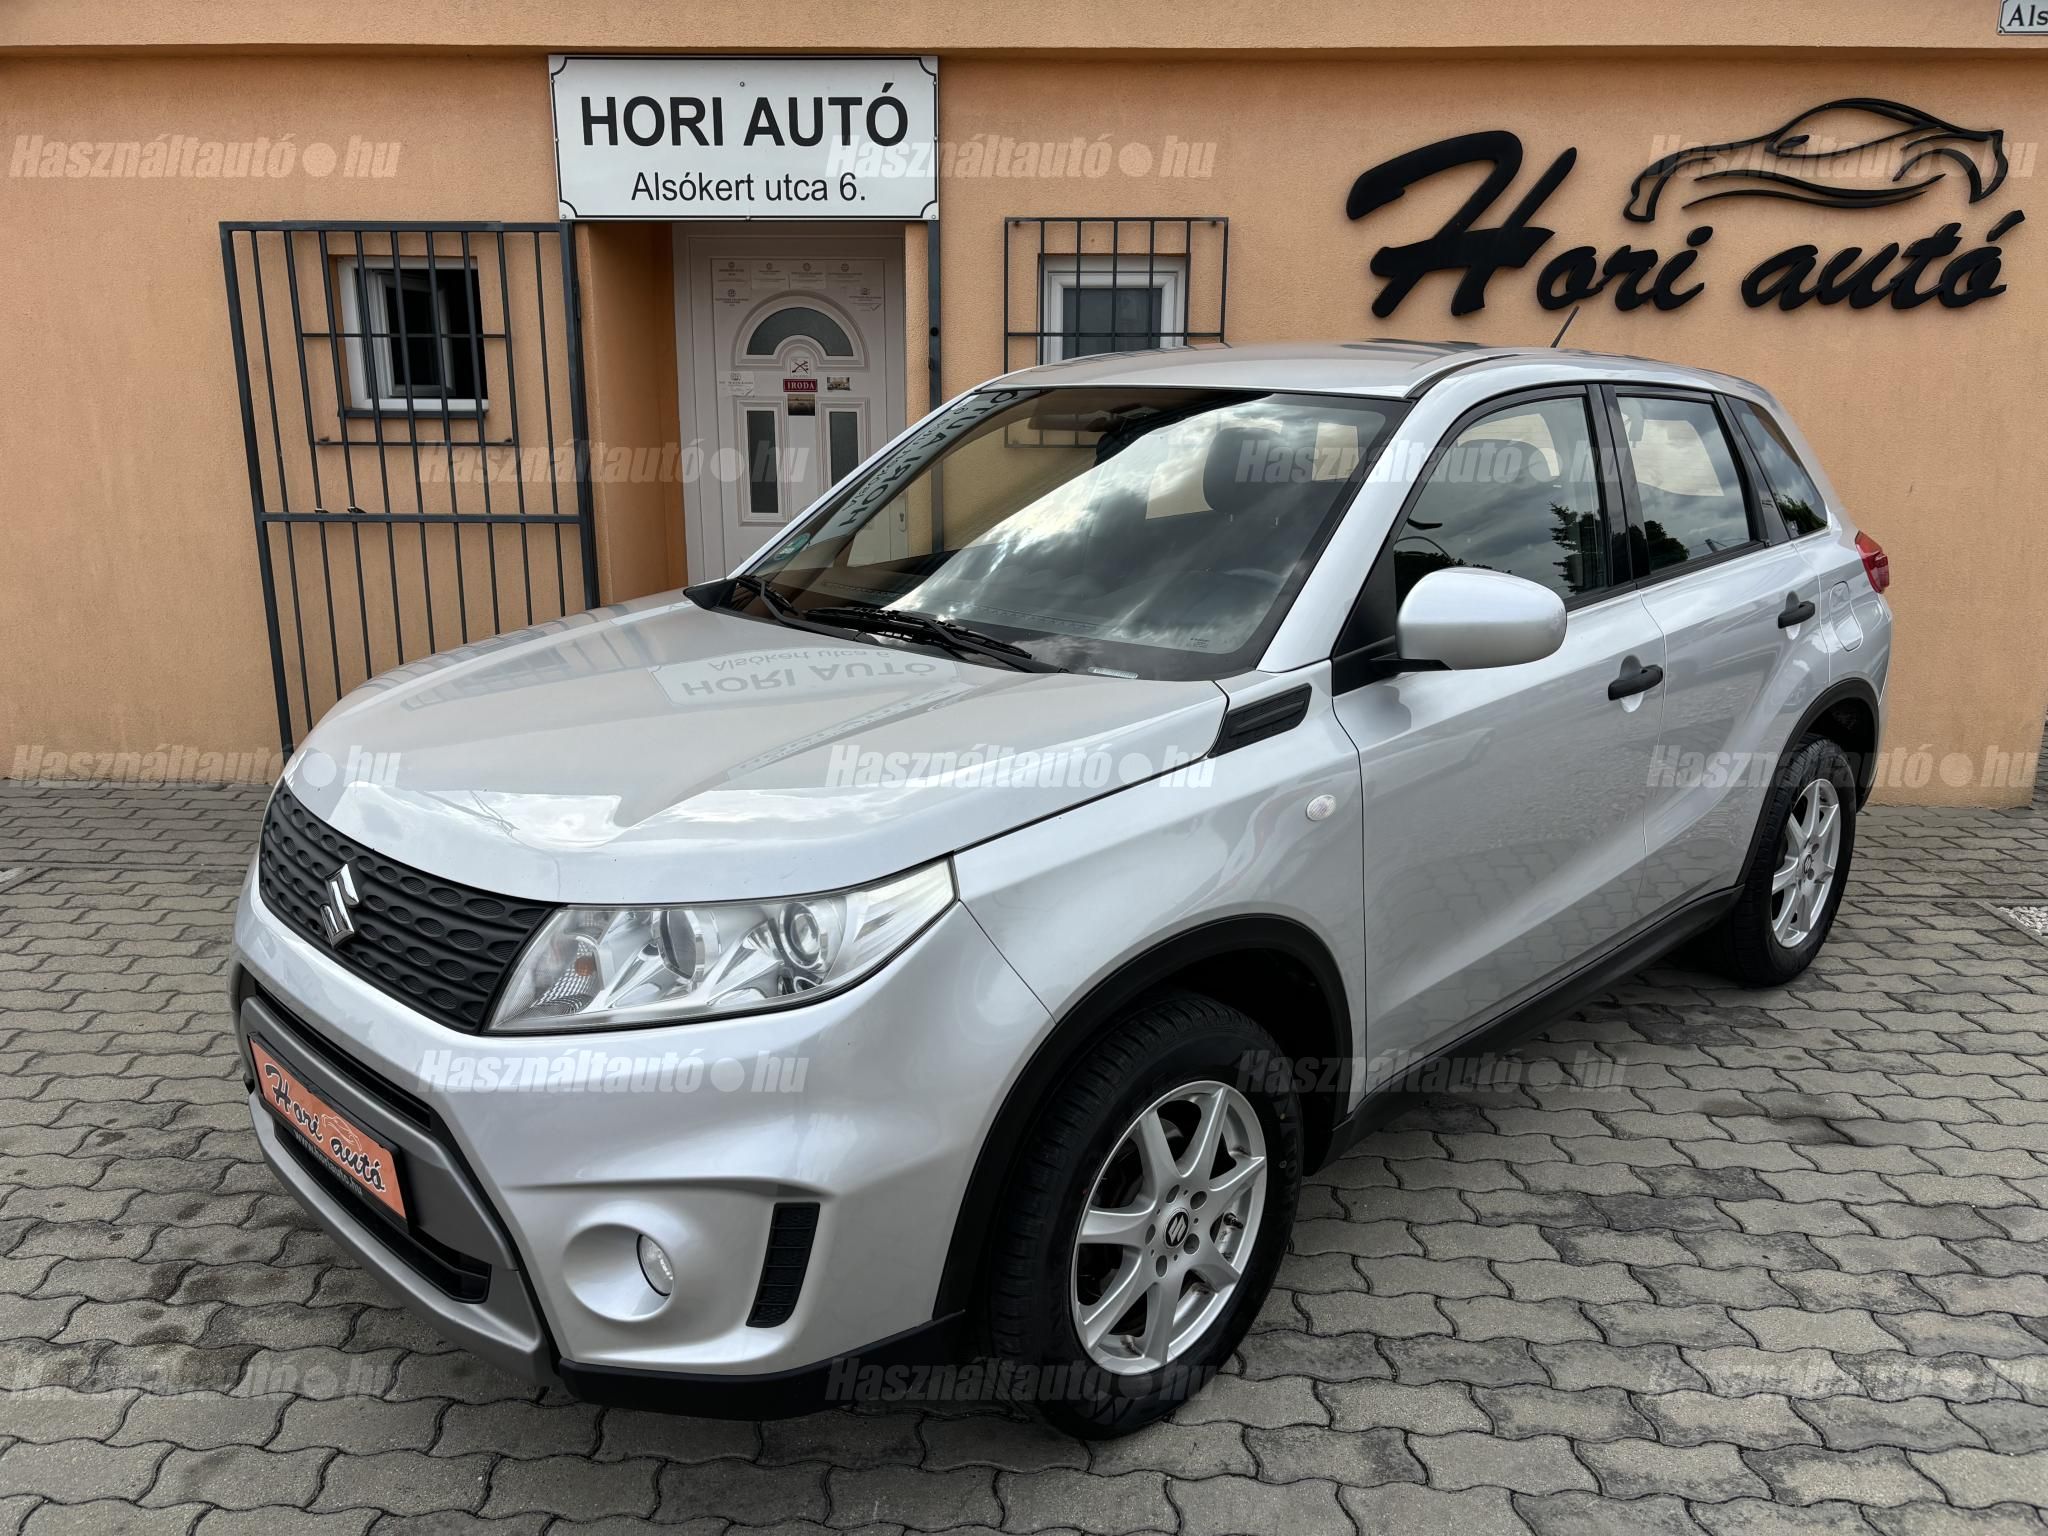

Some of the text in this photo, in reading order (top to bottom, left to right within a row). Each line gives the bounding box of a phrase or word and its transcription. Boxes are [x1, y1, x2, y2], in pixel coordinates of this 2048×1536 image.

[581, 82, 909, 147] HORI AUTÓ
[631, 171, 867, 202] Alsókert utca 6.
[1346, 130, 2026, 318] Hori autó
[787, 381, 815, 390] IRODA
[264, 1063, 323, 1142] Hori
[329, 1137, 386, 1192] autó
